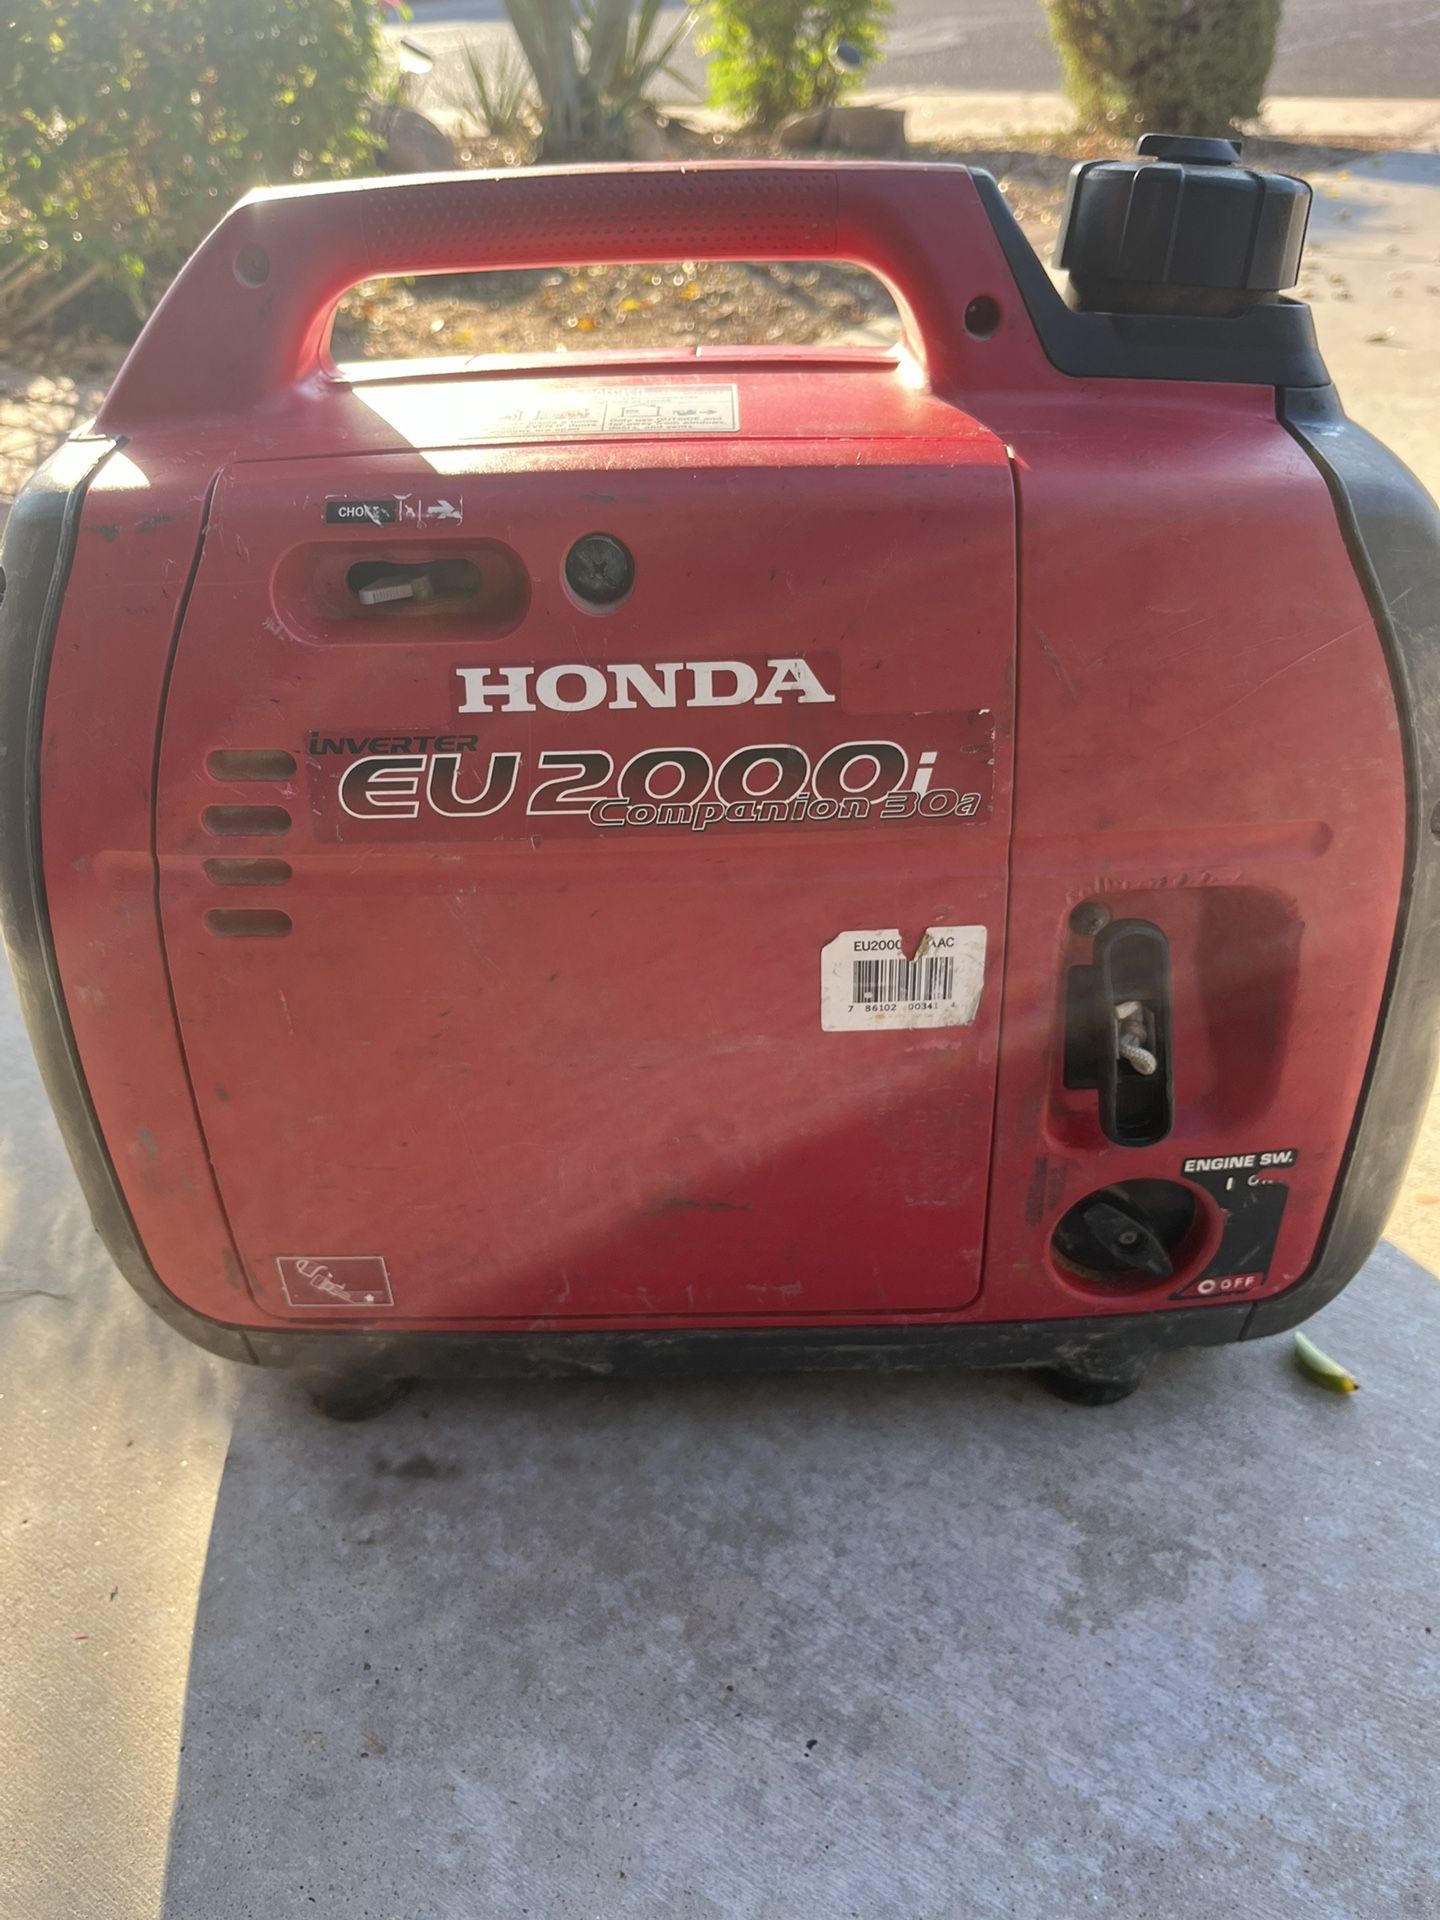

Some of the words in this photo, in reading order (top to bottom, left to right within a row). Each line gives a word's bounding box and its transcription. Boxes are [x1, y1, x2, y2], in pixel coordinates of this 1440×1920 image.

[456, 659, 835, 713] HONDA
[588, 792, 871, 831] Companion
[848, 1005, 854, 1013] 7
[865, 1003, 897, 1012] 86102
[1184, 1155, 1256, 1173] ENGINE
[1259, 1150, 1293, 1166] SW.
[1220, 1276, 1256, 1290] OFF
